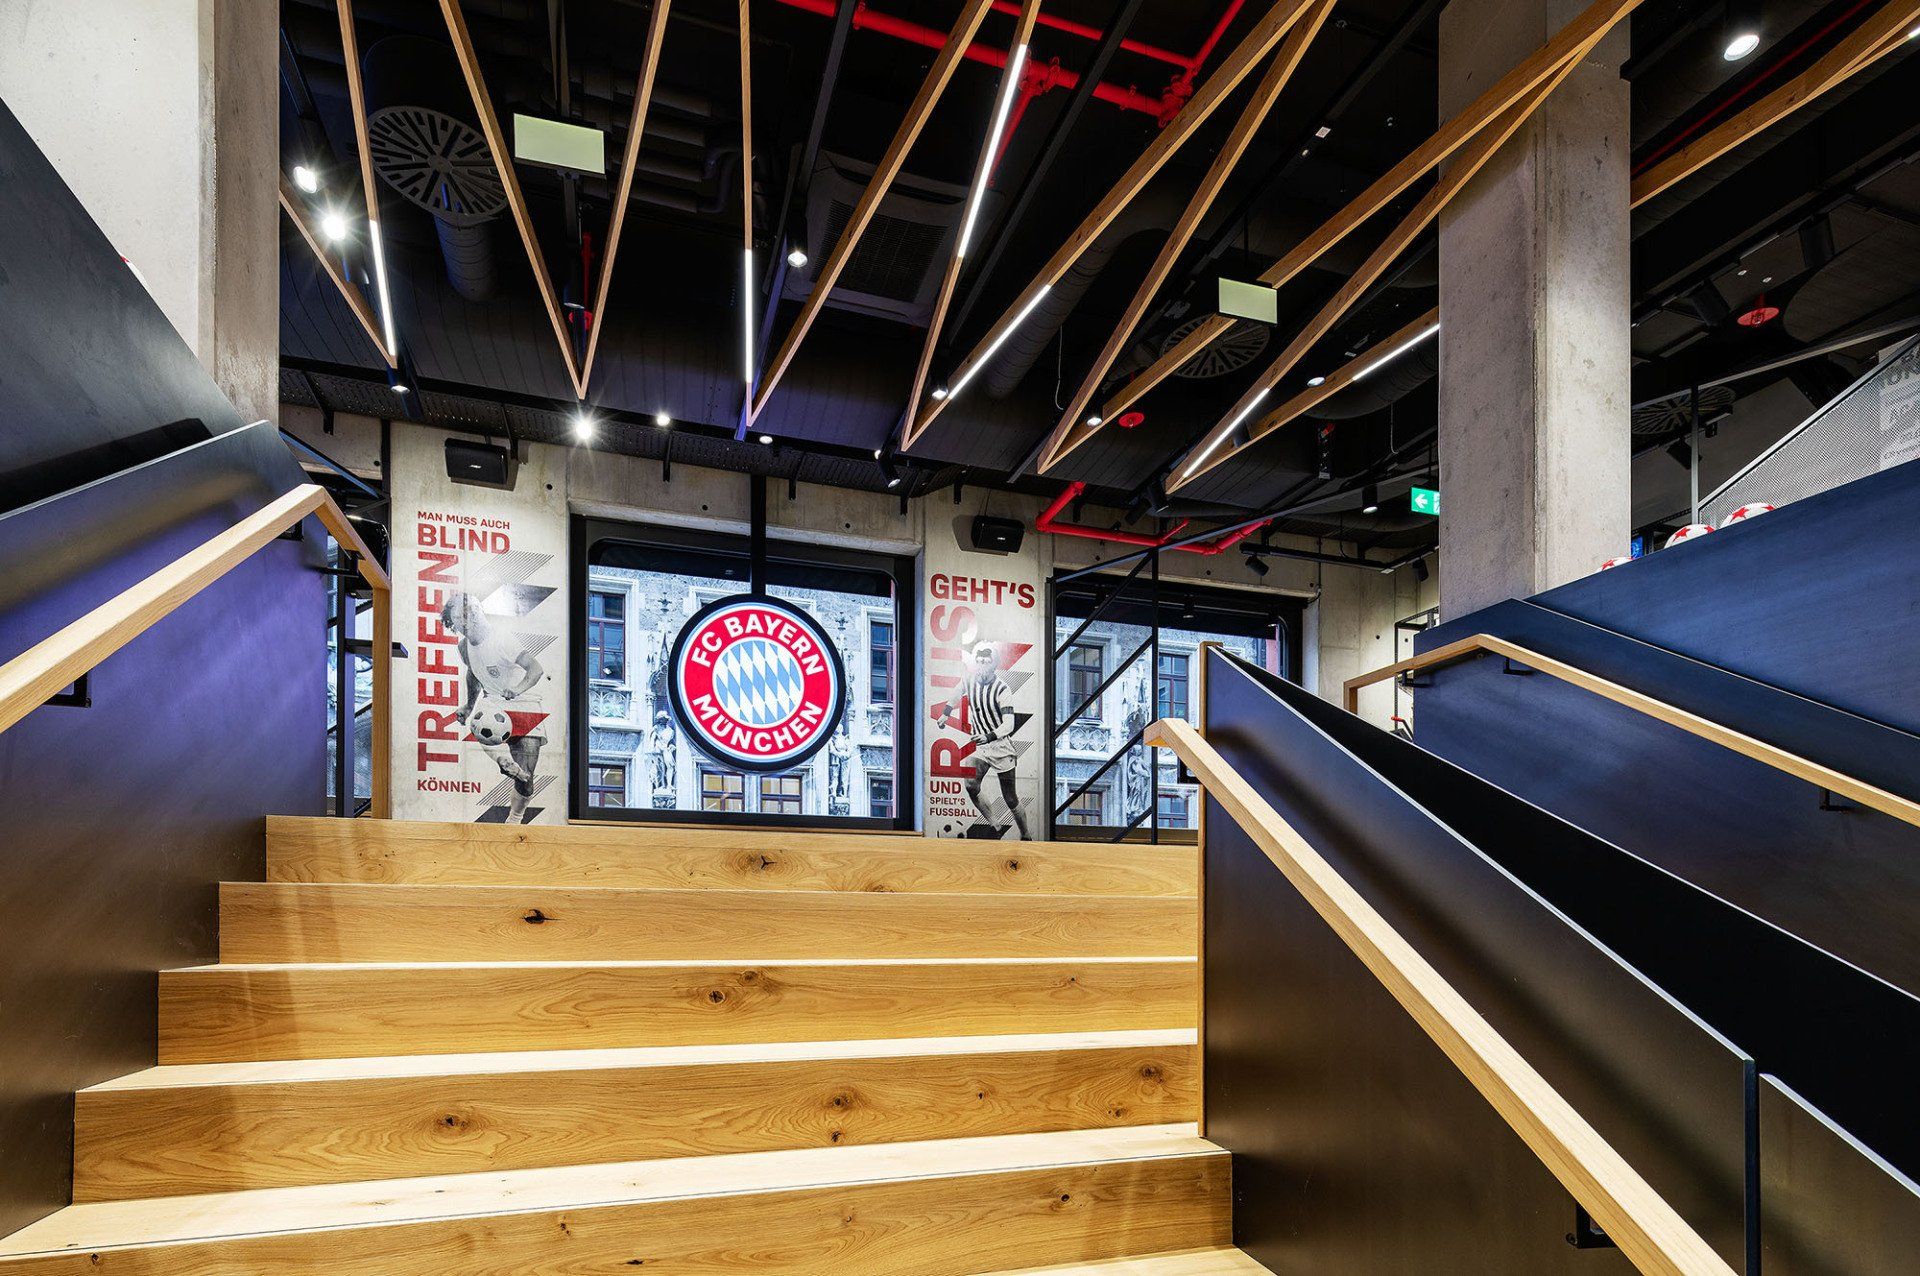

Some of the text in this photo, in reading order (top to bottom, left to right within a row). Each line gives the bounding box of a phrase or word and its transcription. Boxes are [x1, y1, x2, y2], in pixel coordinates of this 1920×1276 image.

[417, 511, 510, 529] MAN MUSS AUCH
[418, 523, 510, 554] BLIND
[930, 573, 1035, 608] GEHT'S
[691, 613, 825, 676] FC BAYERN
[418, 551, 459, 771] TREFFEN
[692, 693, 823, 752] MÜNCHEN
[417, 777, 481, 793] KÖNNEN
[930, 781, 962, 794] UND
[930, 797, 966, 805] SPIELT'S
[930, 808, 978, 817] FUSSBALL
